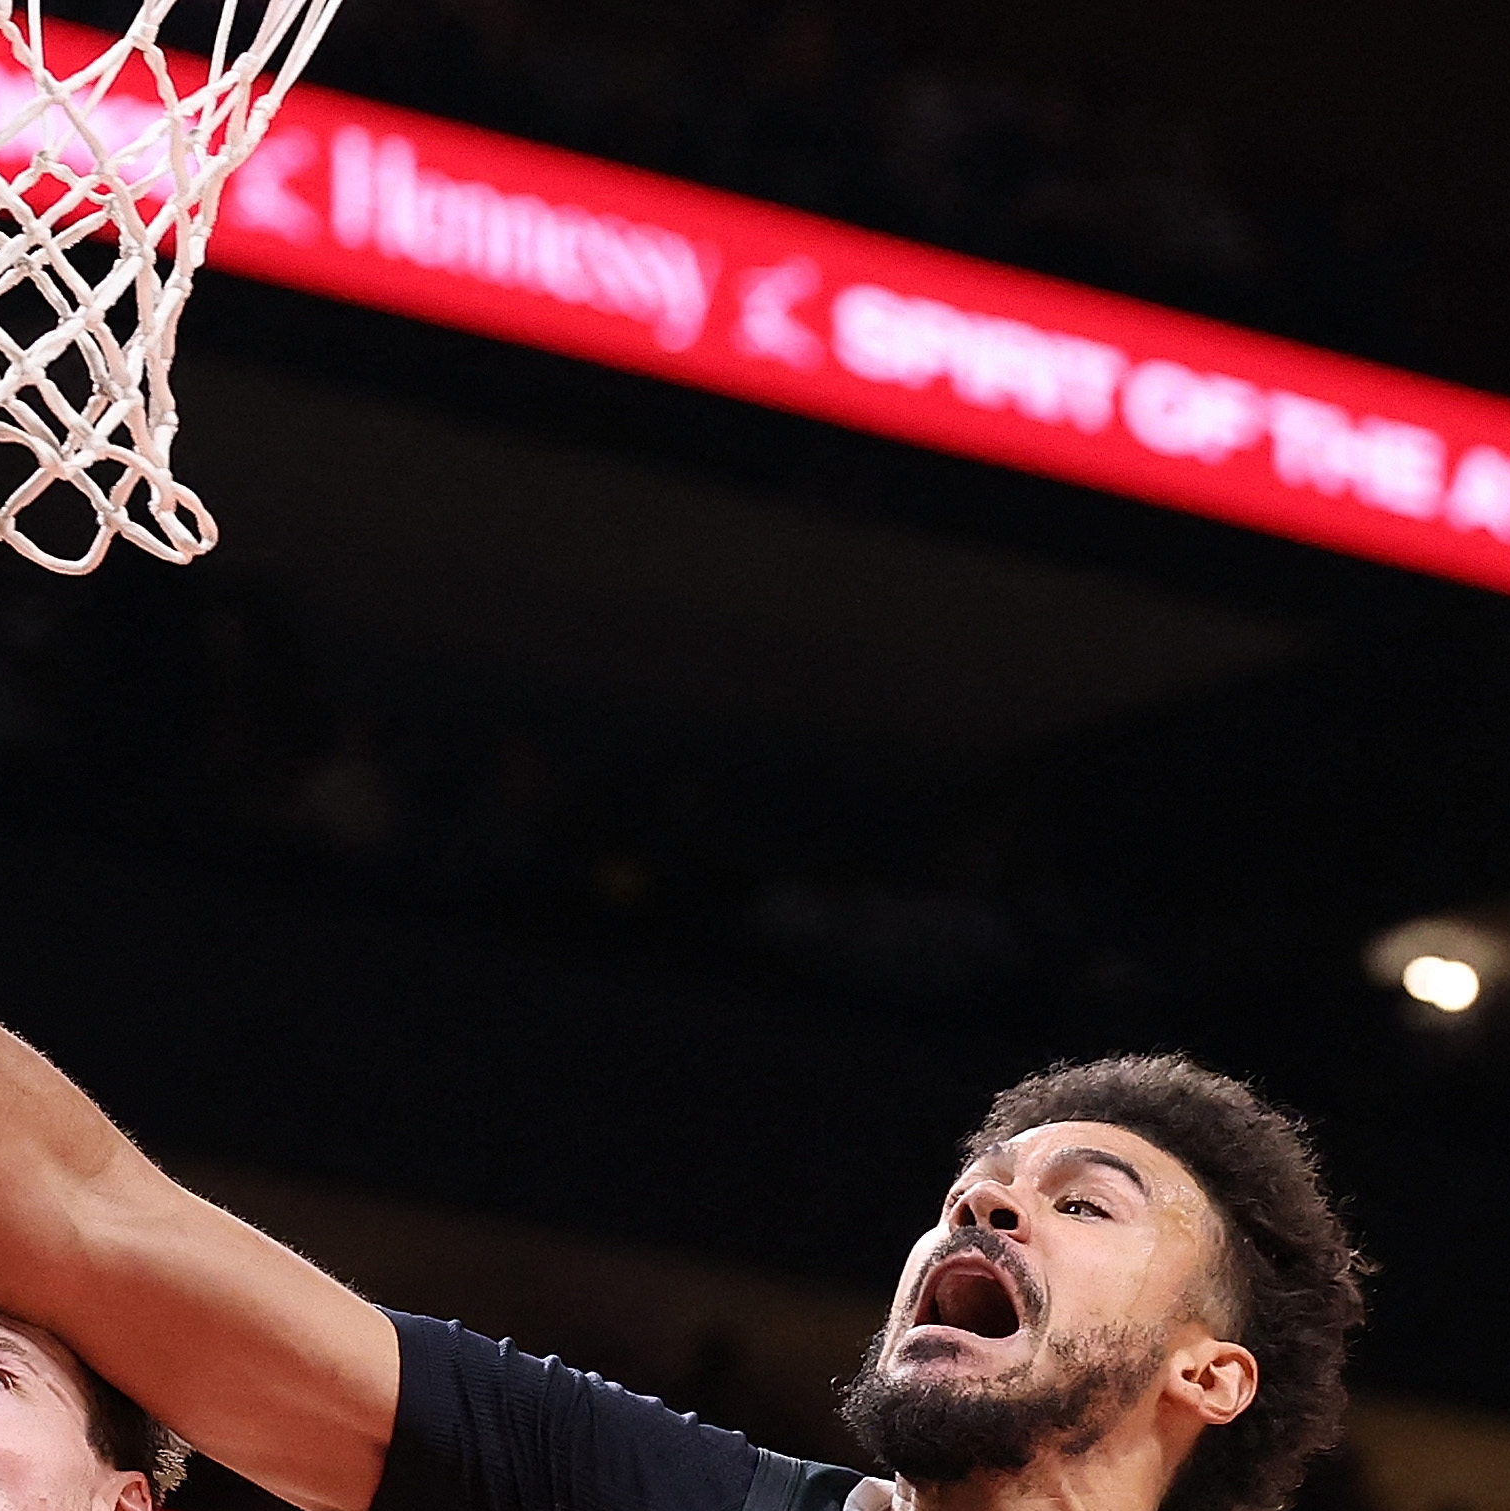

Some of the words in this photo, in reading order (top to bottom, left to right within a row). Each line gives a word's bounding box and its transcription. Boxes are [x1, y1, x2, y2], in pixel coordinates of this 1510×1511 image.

[329, 124, 721, 353] Hennessy
[831, 282, 1125, 434] SPIRIT
[1123, 358, 1266, 465] OF
[1267, 388, 1444, 522] THE
